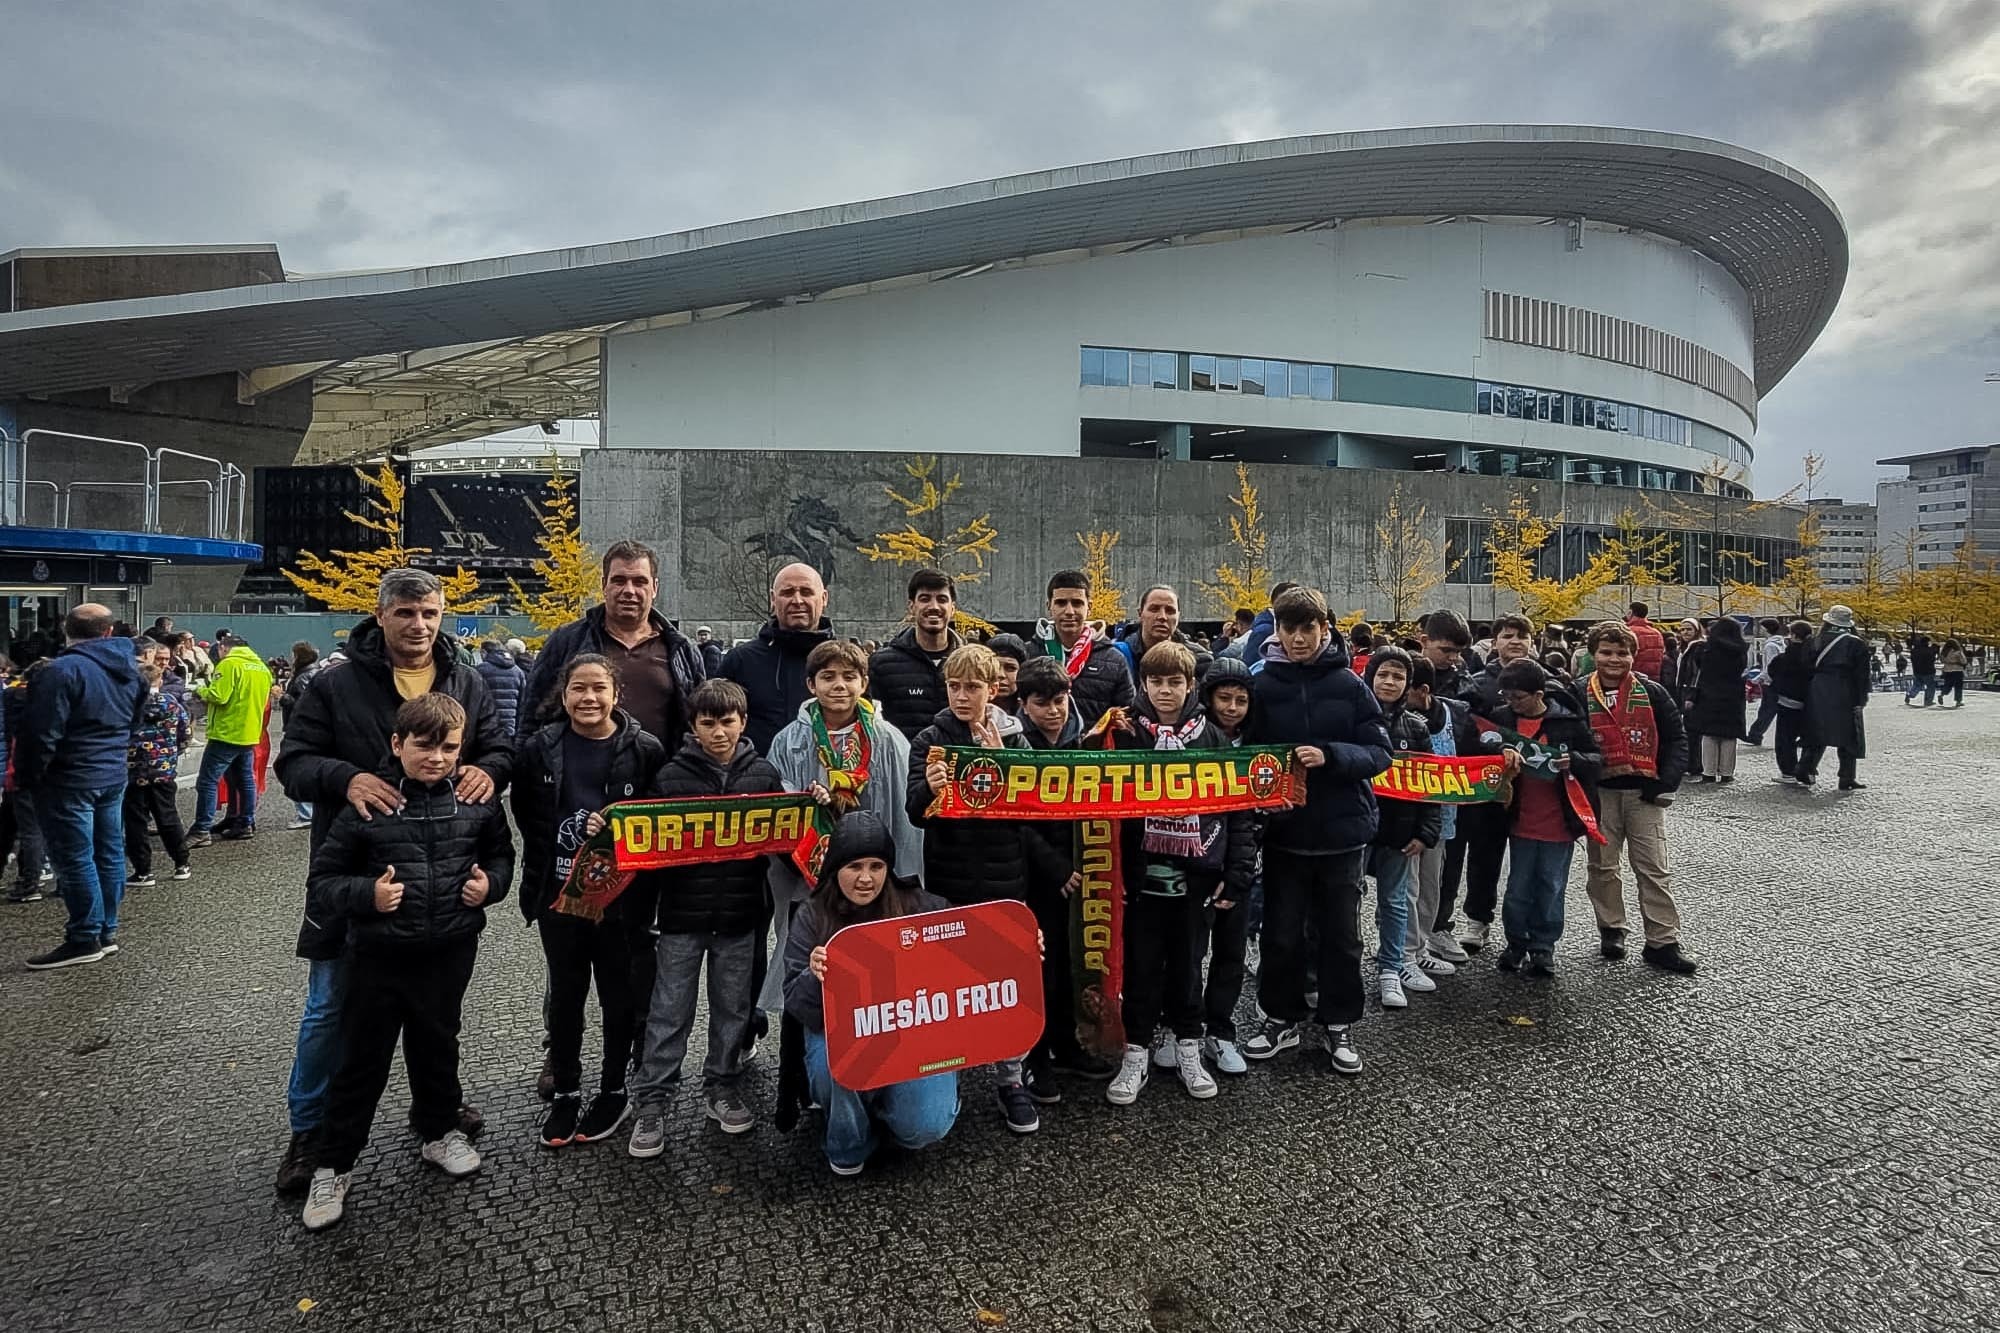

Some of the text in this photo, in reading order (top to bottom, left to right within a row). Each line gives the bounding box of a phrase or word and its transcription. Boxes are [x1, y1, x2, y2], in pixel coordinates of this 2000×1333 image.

[1005, 760, 1248, 804] PORTUGAL
[1371, 758, 1476, 796] RTUGAL
[1146, 820, 1200, 834] PORTUGAL
[1081, 820, 1113, 976] PORTUG
[922, 920, 965, 936] PORTUGAL
[854, 978, 1018, 1038] MESÃO FRIO
